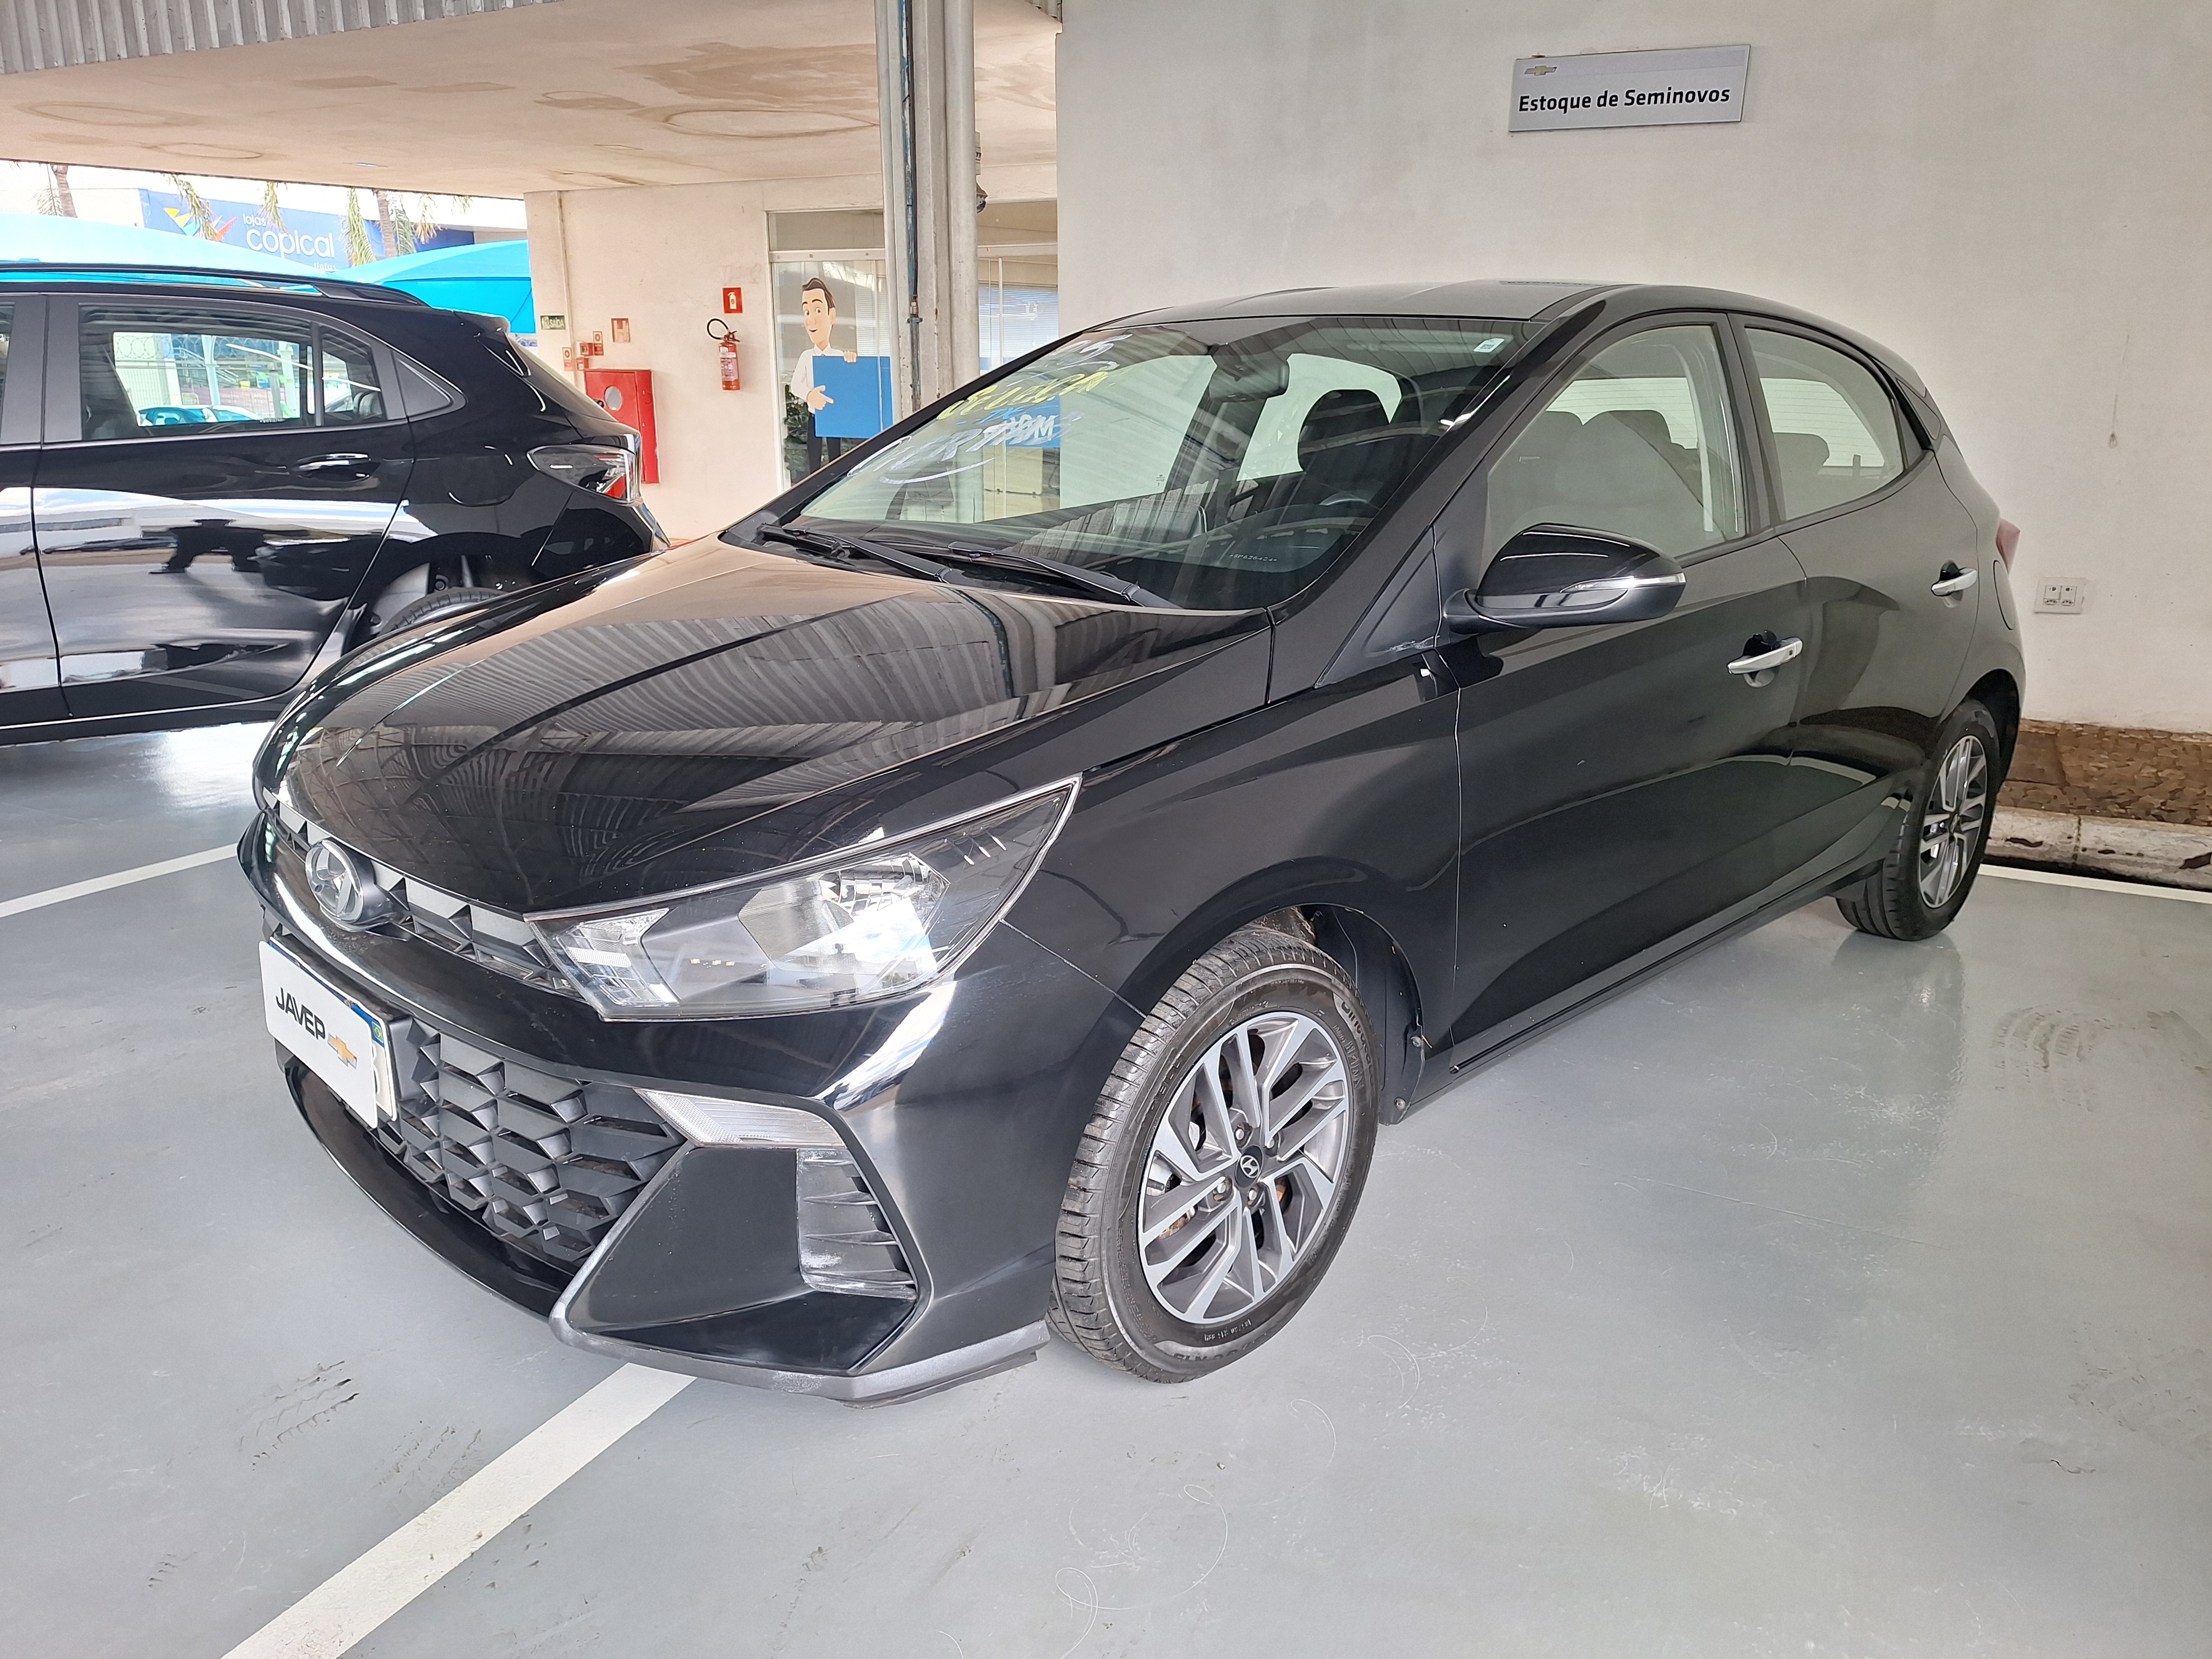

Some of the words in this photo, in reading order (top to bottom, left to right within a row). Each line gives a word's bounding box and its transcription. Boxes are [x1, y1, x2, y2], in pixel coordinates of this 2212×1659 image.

[1519, 95, 1591, 114] Estoque
[1597, 91, 1618, 107] de
[1624, 87, 1730, 106] Seminovos
[242, 213, 266, 227] lojas
[246, 229, 335, 259] copical
[275, 986, 326, 1040] JAVEP
